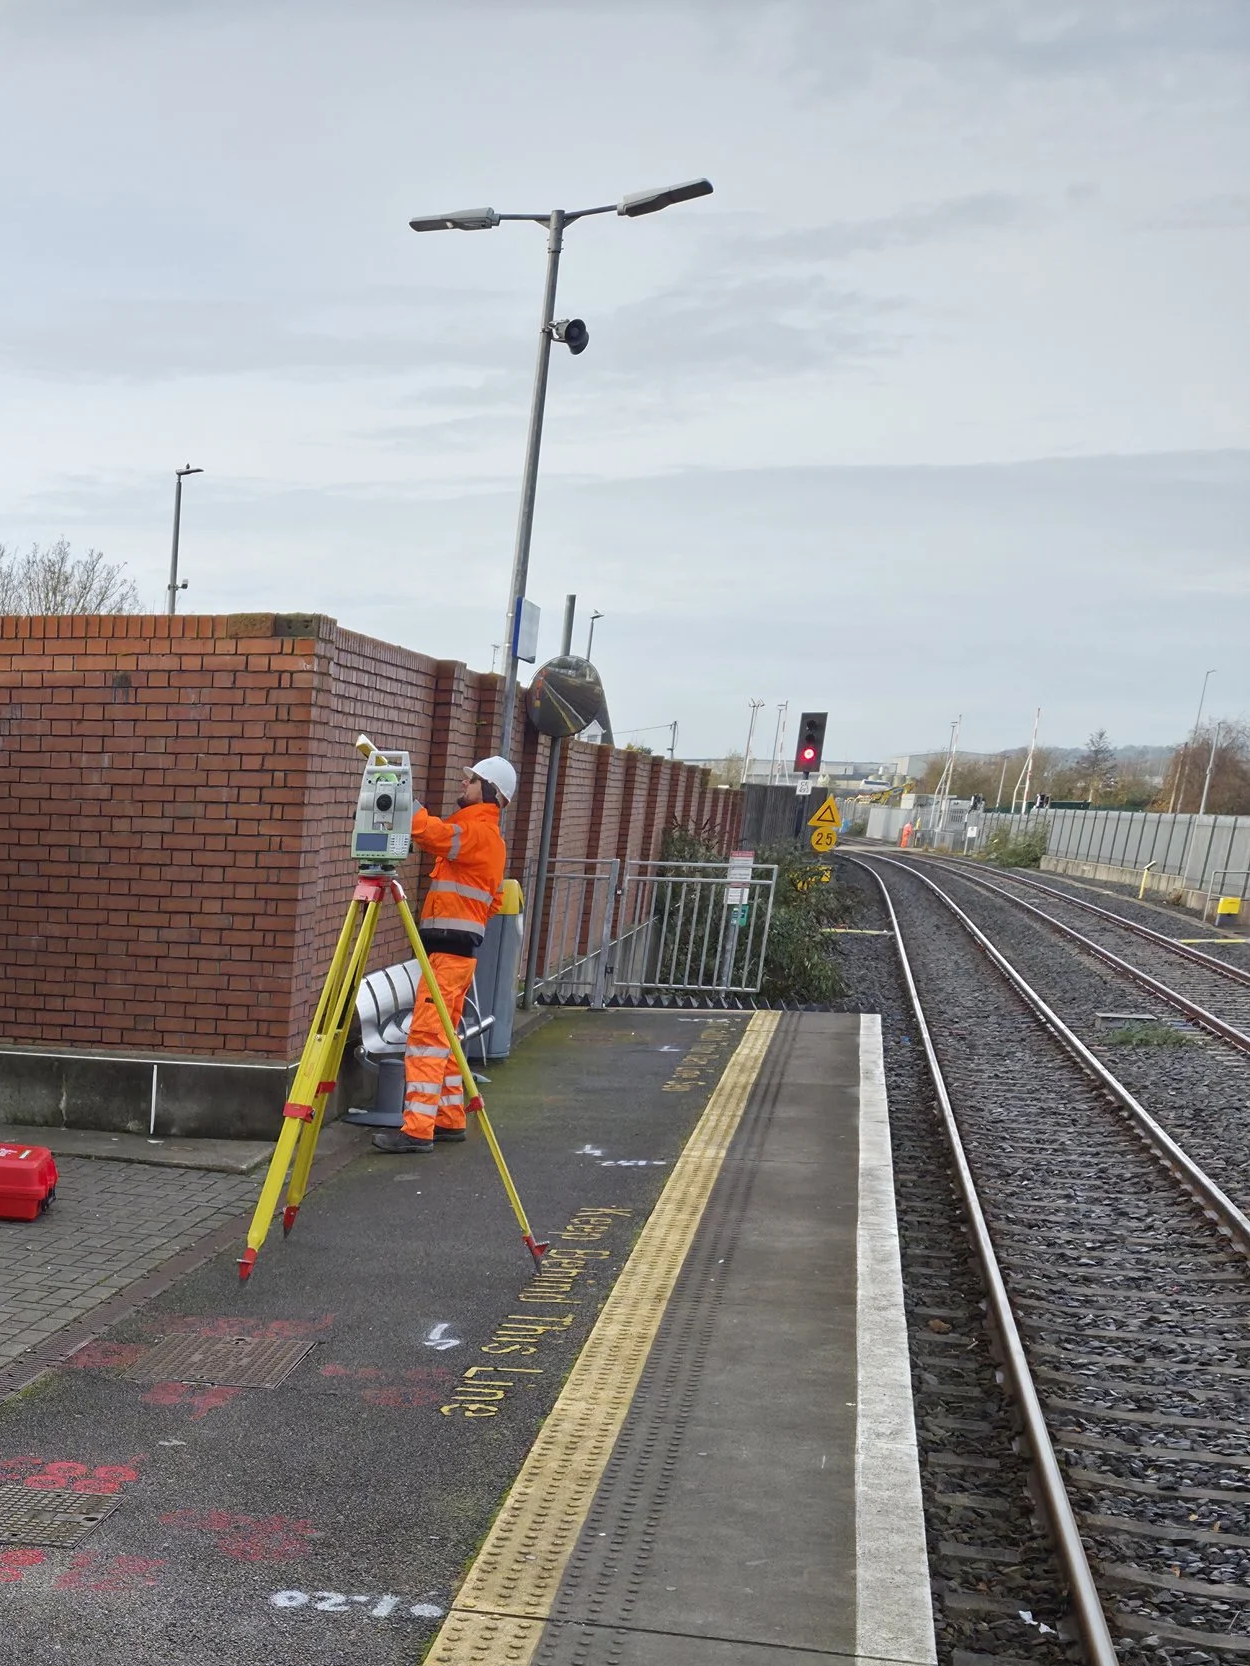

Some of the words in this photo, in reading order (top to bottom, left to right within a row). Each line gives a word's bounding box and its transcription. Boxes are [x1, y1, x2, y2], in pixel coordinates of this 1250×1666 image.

[815, 832, 833, 846] 25
[548, 1207, 634, 1240] Keep
[517, 1249, 610, 1304] Behind
[481, 1313, 574, 1355] This
[439, 1366, 544, 1418] Line
